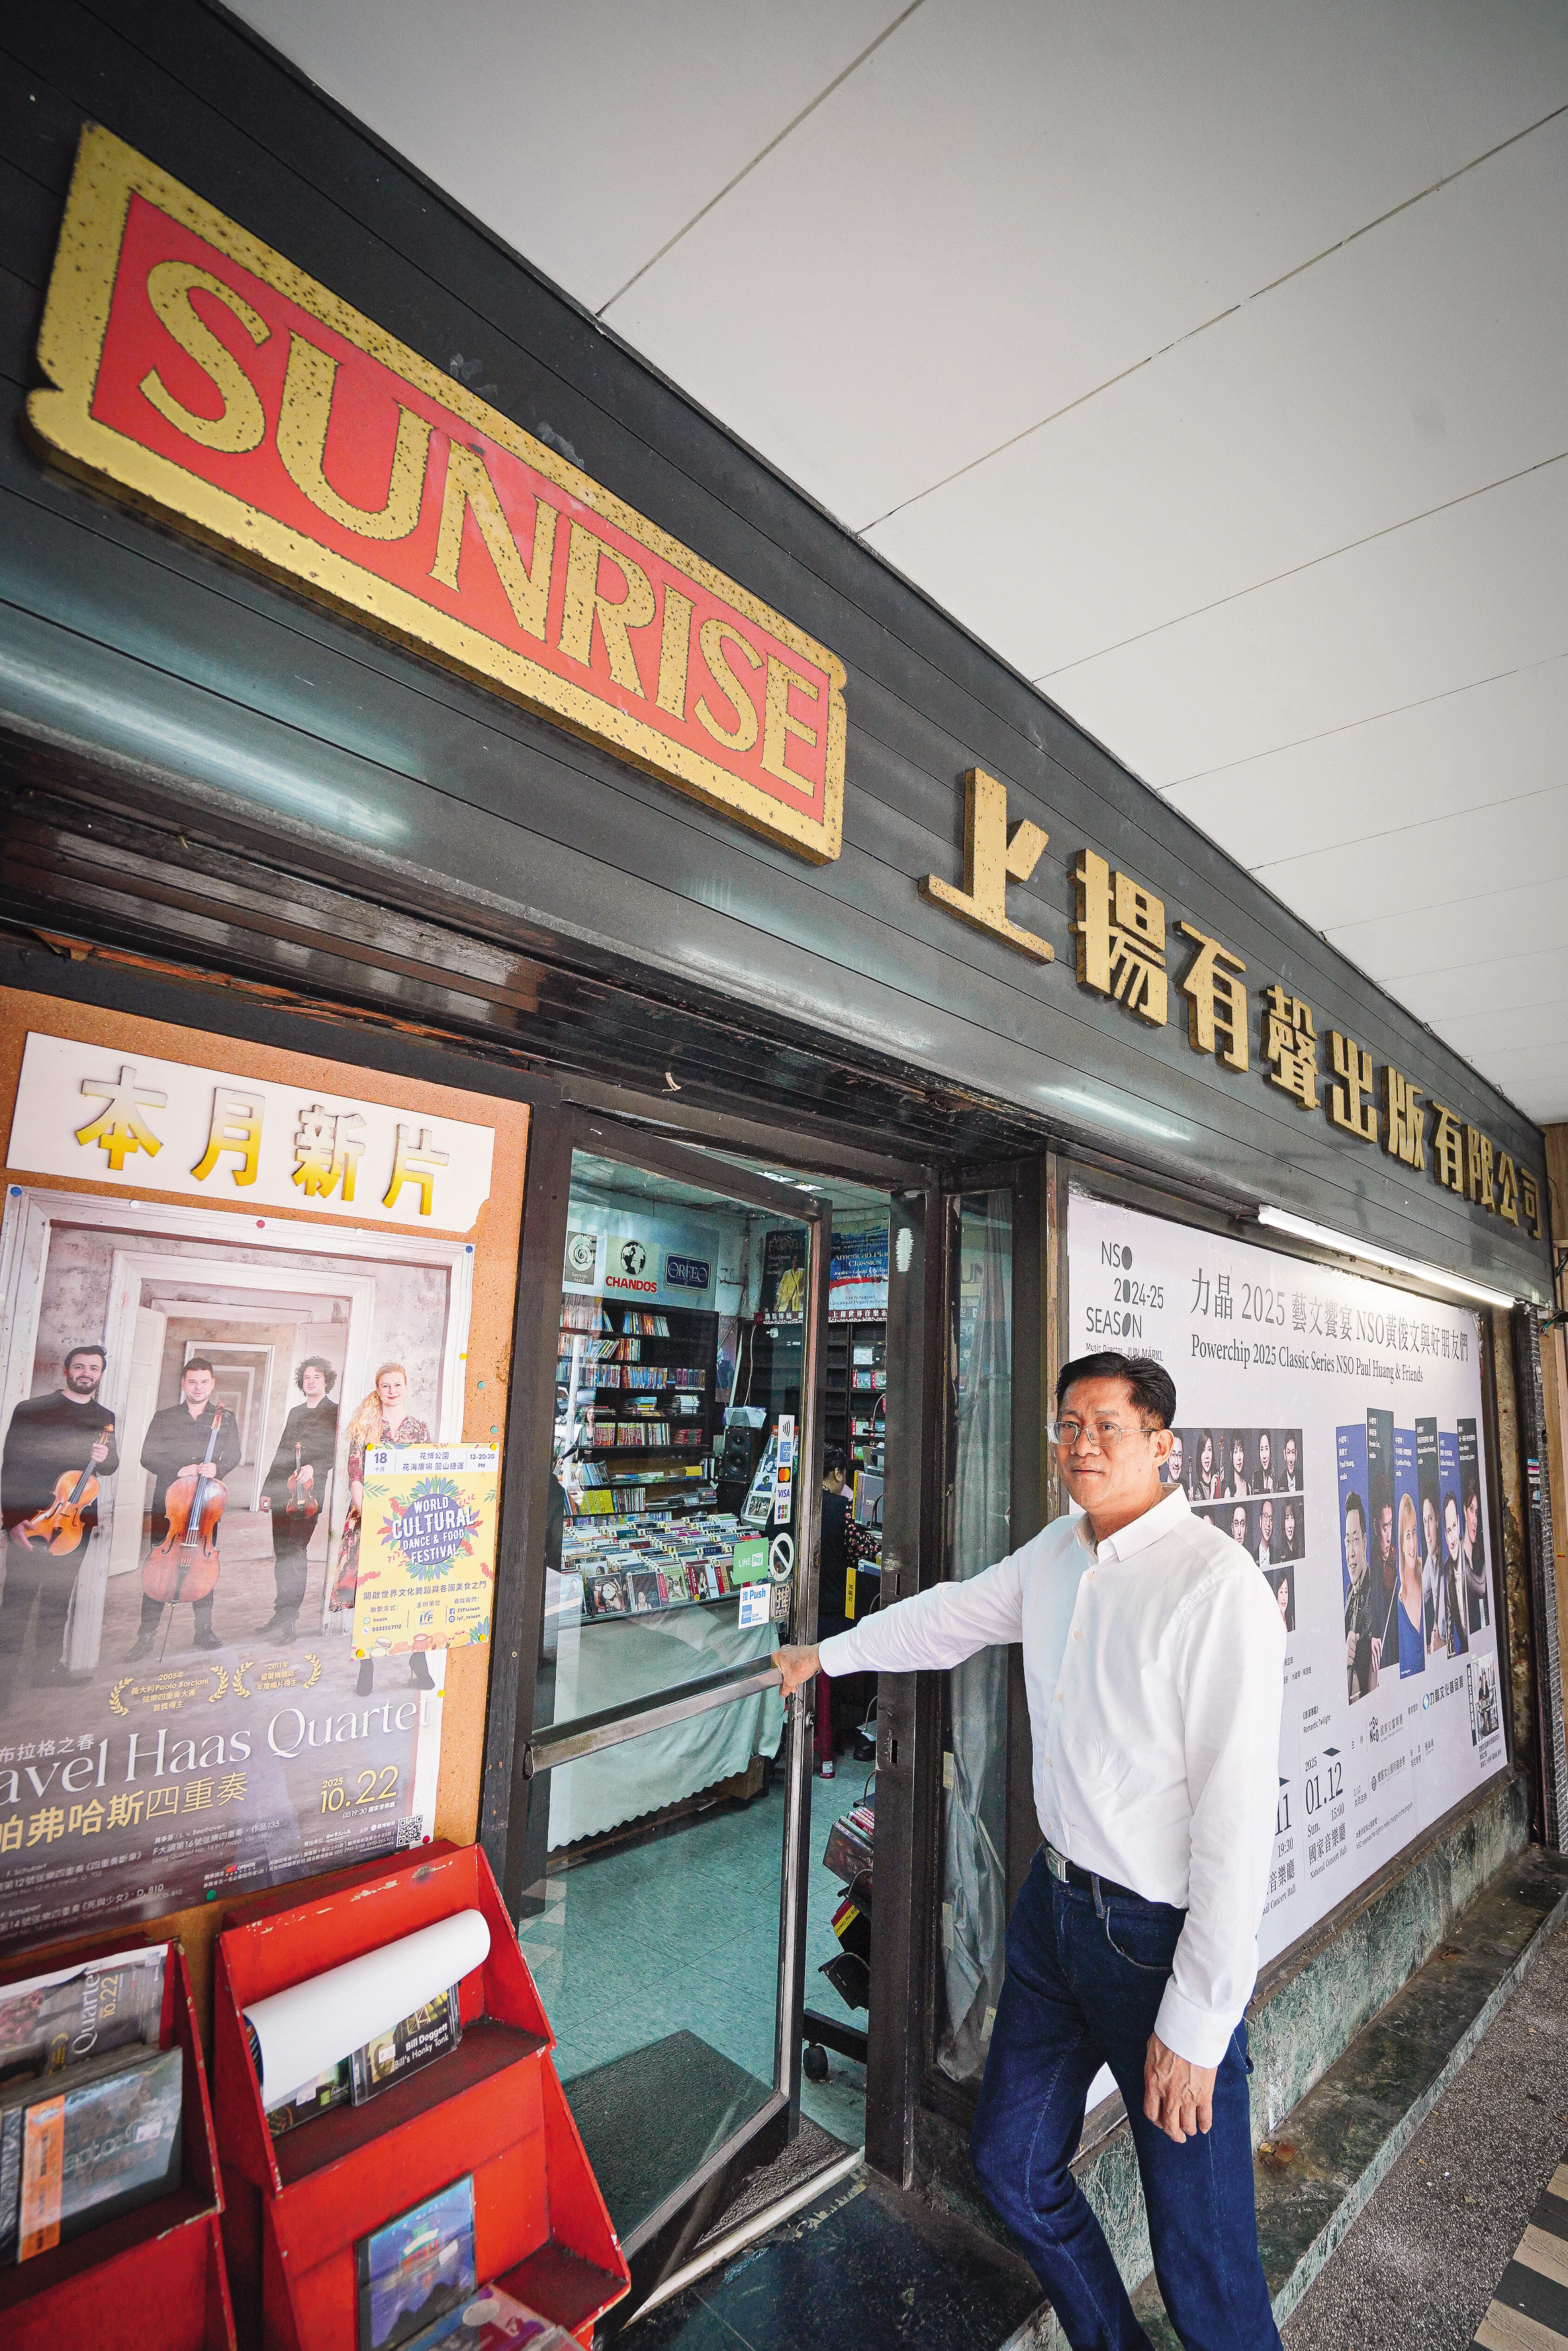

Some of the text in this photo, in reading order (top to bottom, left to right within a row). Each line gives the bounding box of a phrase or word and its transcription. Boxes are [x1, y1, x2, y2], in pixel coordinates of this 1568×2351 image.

[138, 260, 821, 797] SUNRISE
[917, 766, 1542, 1239] 上揚有聲出版有限公司
[75, 1066, 450, 1216] 本月新片
[835, 1252, 872, 1261] American
[848, 1259, 882, 1268] Classics
[1101, 1241, 1133, 1270] NSO
[667, 1260, 708, 1284] ORFEO
[605, 1275, 657, 1293] CHANDOS
[1114, 1278, 1164, 1309] 2024-25
[1190, 1268, 1234, 1320] 力晶
[1242, 1283, 1285, 1326] 2025
[1291, 1291, 1352, 1341] 藝文饗宴
[1086, 1306, 1142, 1339] SEASON
[1086, 1343, 1101, 1352] Music
[1142, 1345, 1164, 1362] MÄRKL
[1191, 1333, 1424, 1384] Powerchip 2025 Classic Series NSO Paul Huang & Friends
[374, 1452, 387, 1464] 18
[402, 1462, 465, 1471] 花海廣場 圓山捷運
[420, 1452, 449, 1460] 花博公園
[778, 1489, 790, 1498] VISA
[414, 1496, 450, 1514] WORLD
[778, 1505, 788, 1519] JCB
[391, 1506, 475, 1540] CULTURAL
[402, 1529, 465, 1551] DANCE & FOOD
[410, 1543, 459, 1564] FESTIVAL
[739, 1555, 762, 1568] LINE Pay
[363, 1581, 487, 1600] 開啟世界文化舞蹈與各國美食之門
[742, 1587, 766, 1601] 推 Push
[416, 1600, 441, 1608] 主辦單位
[158, 1671, 185, 1681] 2005年
[267, 1660, 289, 1671] 2011年
[179, 1677, 210, 1688] Borciani
[0, 1733, 95, 1765] 布拉格之春
[0, 1693, 431, 1806] avel Haas Quartet
[1305, 1757, 1318, 1772] 2025
[320, 1765, 399, 1814] 10.22
[322, 1777, 344, 1789] 2025
[1305, 1761, 1343, 1815] 01.12
[1331, 1802, 1345, 1822] 15:00
[1307, 1822, 1321, 1838] Sun.
[1278, 1836, 1294, 1858] 19:30
[1309, 1822, 1346, 1866] 國家音樂廳
[1310, 1844, 1347, 1880] National Concert Hall
[1268, 1859, 1295, 1895] 音樂廳
[1271, 1890, 1287, 1910] Concert
[1287, 1883, 1296, 1898] Hall
[405, 2023, 448, 2052] Bill Doggett
[394, 2033, 449, 2071] Bill's Honky Tonk
